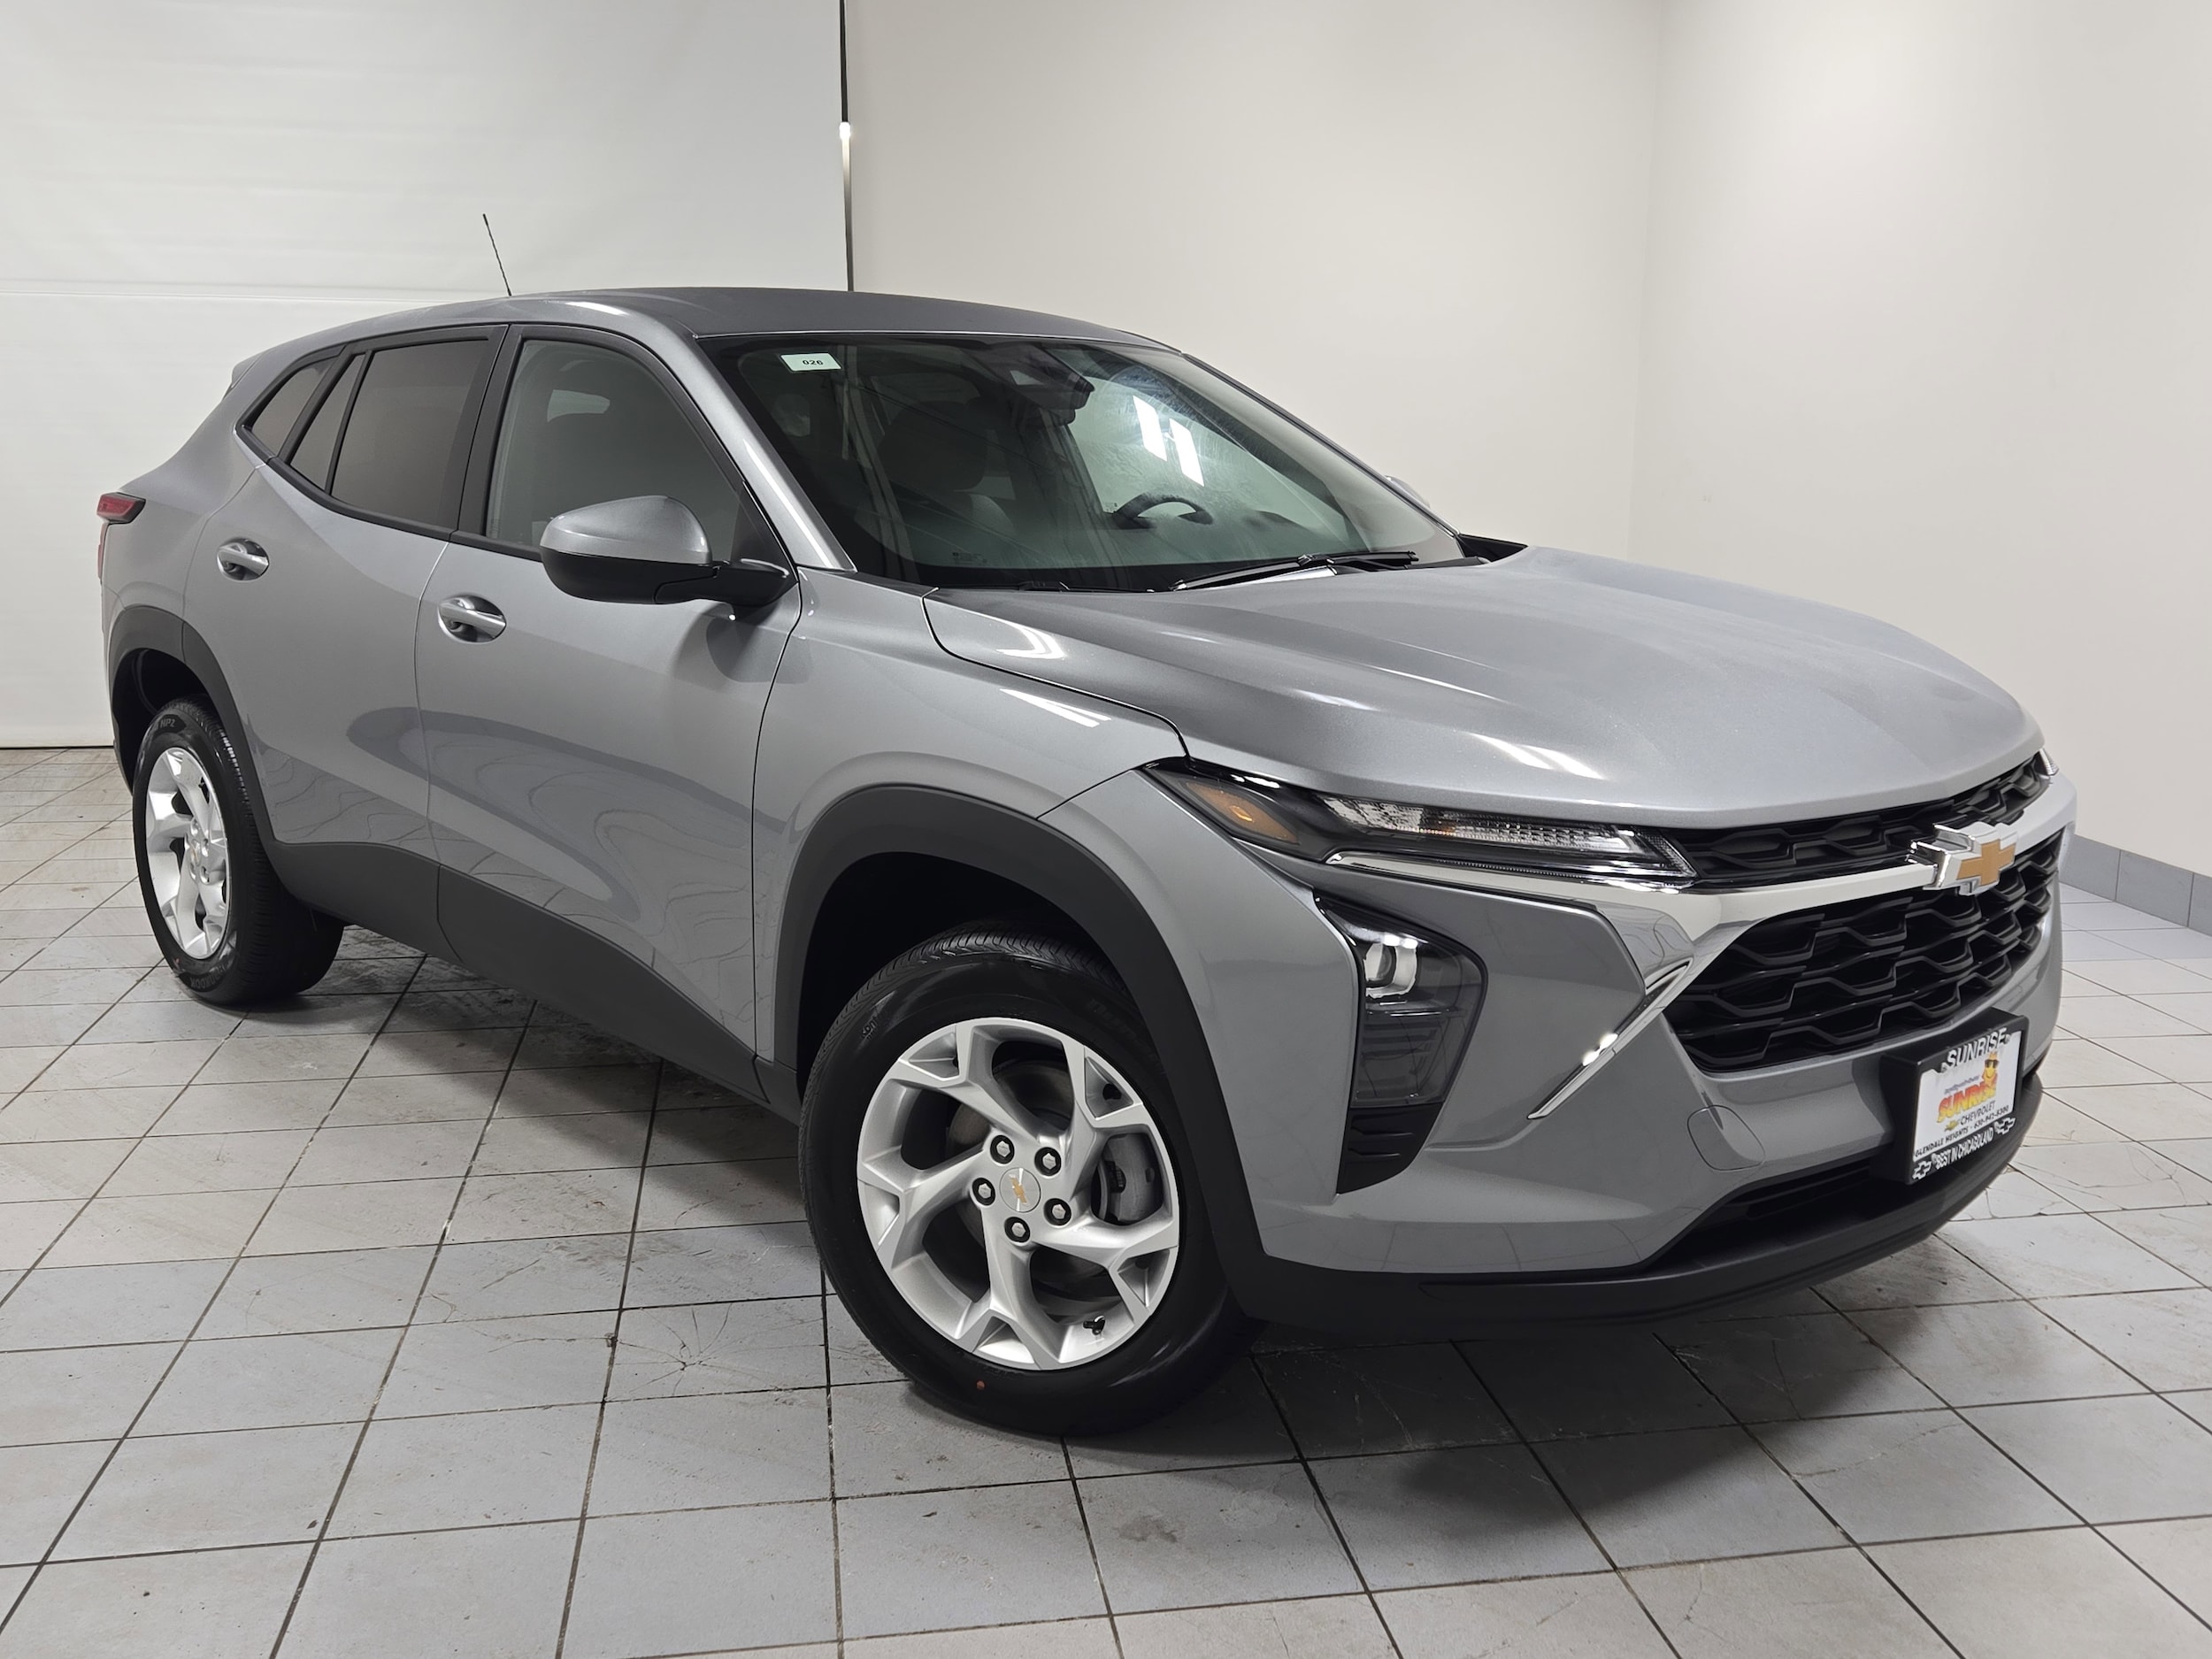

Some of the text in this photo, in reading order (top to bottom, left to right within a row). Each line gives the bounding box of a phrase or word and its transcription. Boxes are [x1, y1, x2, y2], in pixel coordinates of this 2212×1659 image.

[1947, 1027, 2007, 1067] SUNRISE
[1937, 1079, 1997, 1123] SUNRISE
[1960, 1100, 1996, 1125] CHEVROLET
[1915, 1138, 1944, 1157] GLENDALE
[1946, 1126, 1969, 1144] HEIGHTS
[1935, 1149, 1952, 1170] BEST
[1957, 1126, 1994, 1160] CHICAGOLAND
